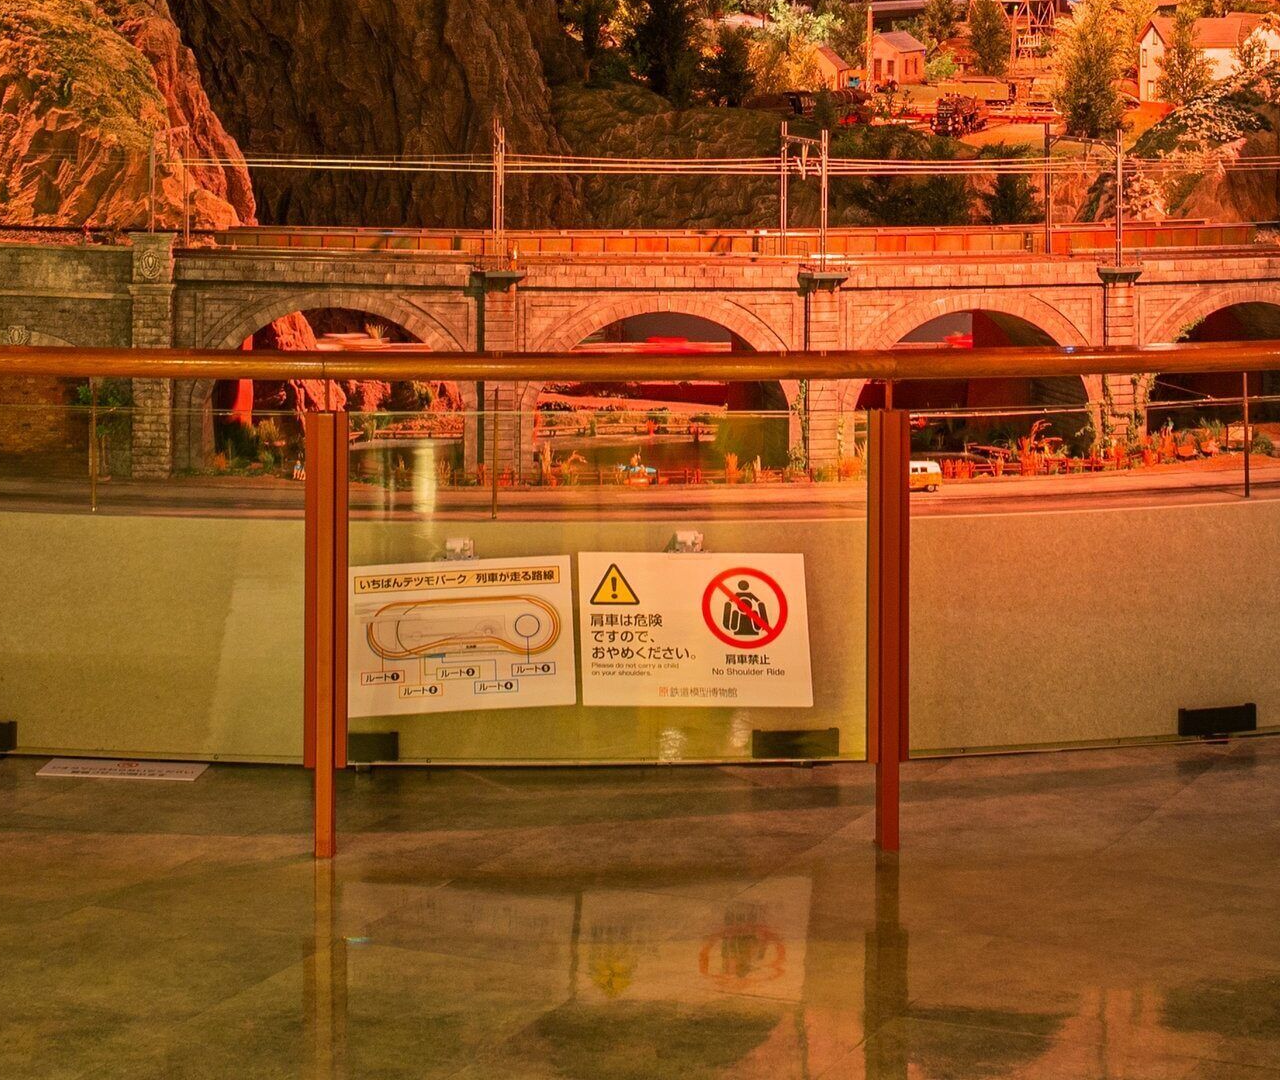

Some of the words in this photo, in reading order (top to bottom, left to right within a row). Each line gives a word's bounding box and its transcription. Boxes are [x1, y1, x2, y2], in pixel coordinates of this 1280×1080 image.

[590, 613, 663, 627] 肩車は危険
[591, 630, 656, 643] ですので、
[591, 647, 697, 660] おやめください。
[725, 654, 771, 665] 肩車禁止
[712, 667, 725, 676] No
[726, 667, 764, 676] Shoulder
[766, 667, 786, 676] Ride
